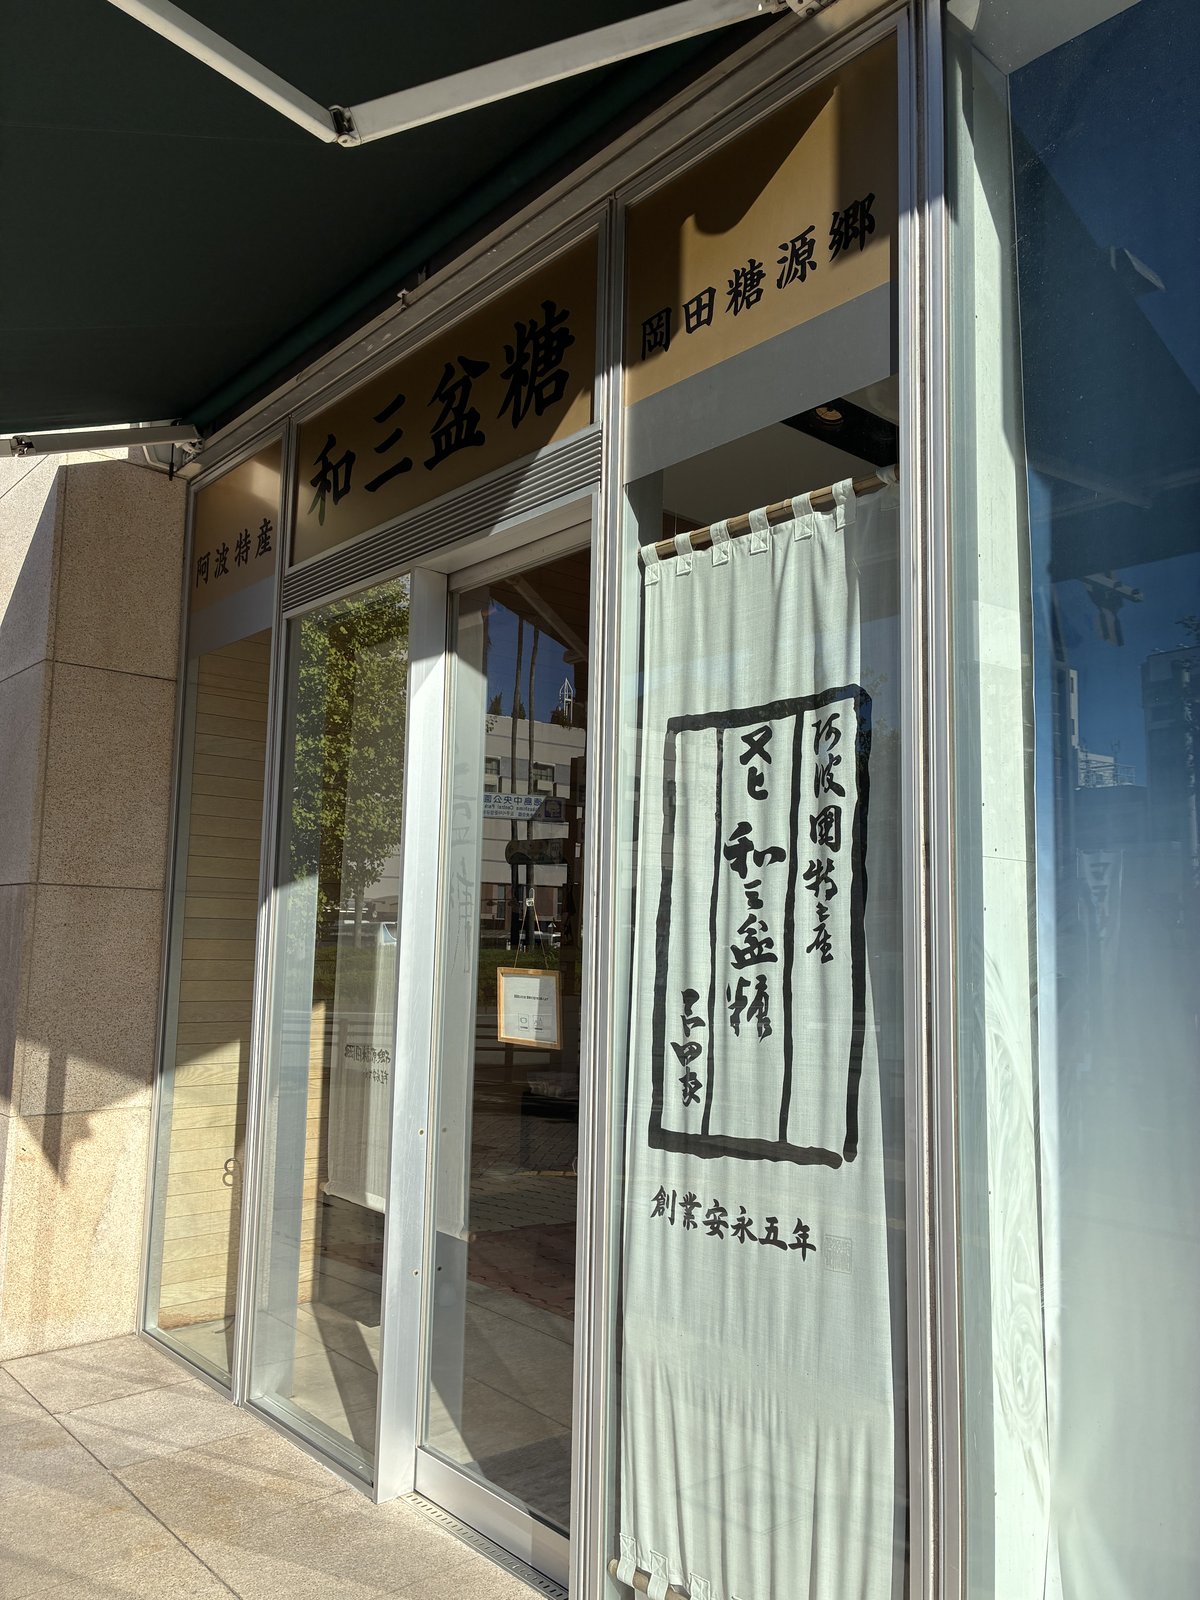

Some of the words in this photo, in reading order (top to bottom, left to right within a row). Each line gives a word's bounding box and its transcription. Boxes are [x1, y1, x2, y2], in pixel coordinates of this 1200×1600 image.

[640, 192, 878, 362] 岡田糖源郷
[306, 300, 577, 527] 和三盆糖
[195, 517, 273, 589] 阿波特産
[650, 1184, 817, 1262] 創業安永五年
